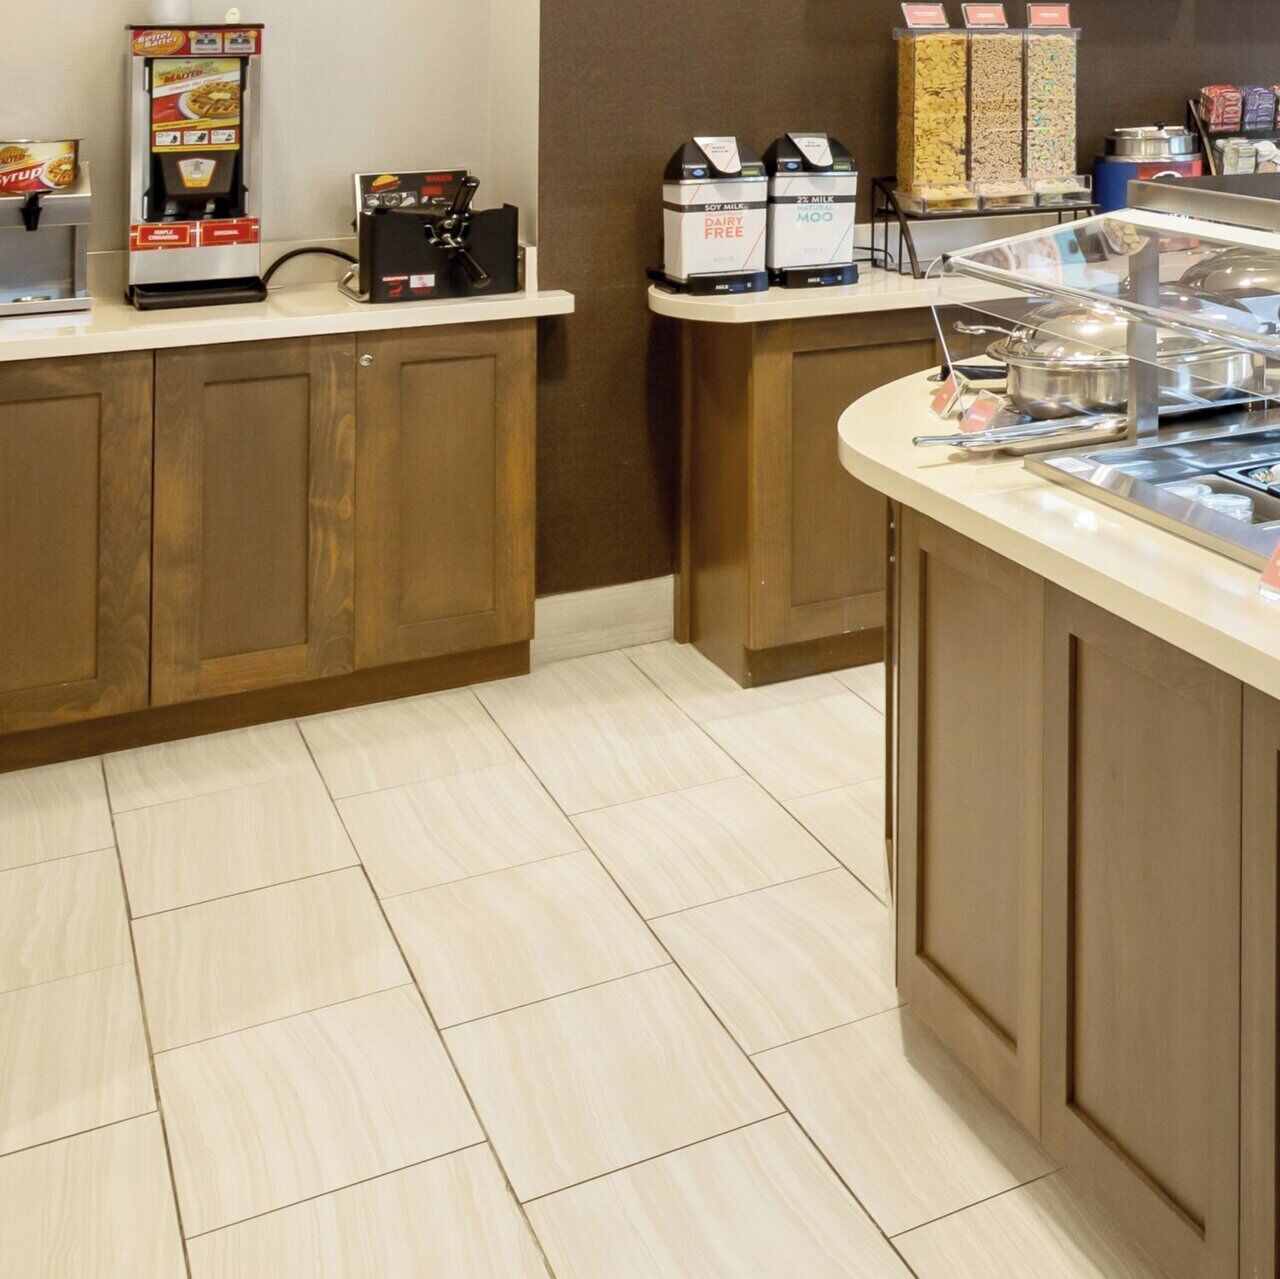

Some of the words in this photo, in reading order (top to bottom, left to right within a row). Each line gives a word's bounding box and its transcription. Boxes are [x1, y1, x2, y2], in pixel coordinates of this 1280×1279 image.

[796, 196, 809, 204] 2%
[811, 195, 834, 203] MILK
[704, 204, 722, 212] SOY
[723, 203, 745, 211] MILK
[704, 216, 743, 227] DAIRY
[796, 212, 834, 224] MOO
[704, 226, 743, 239] FREE
